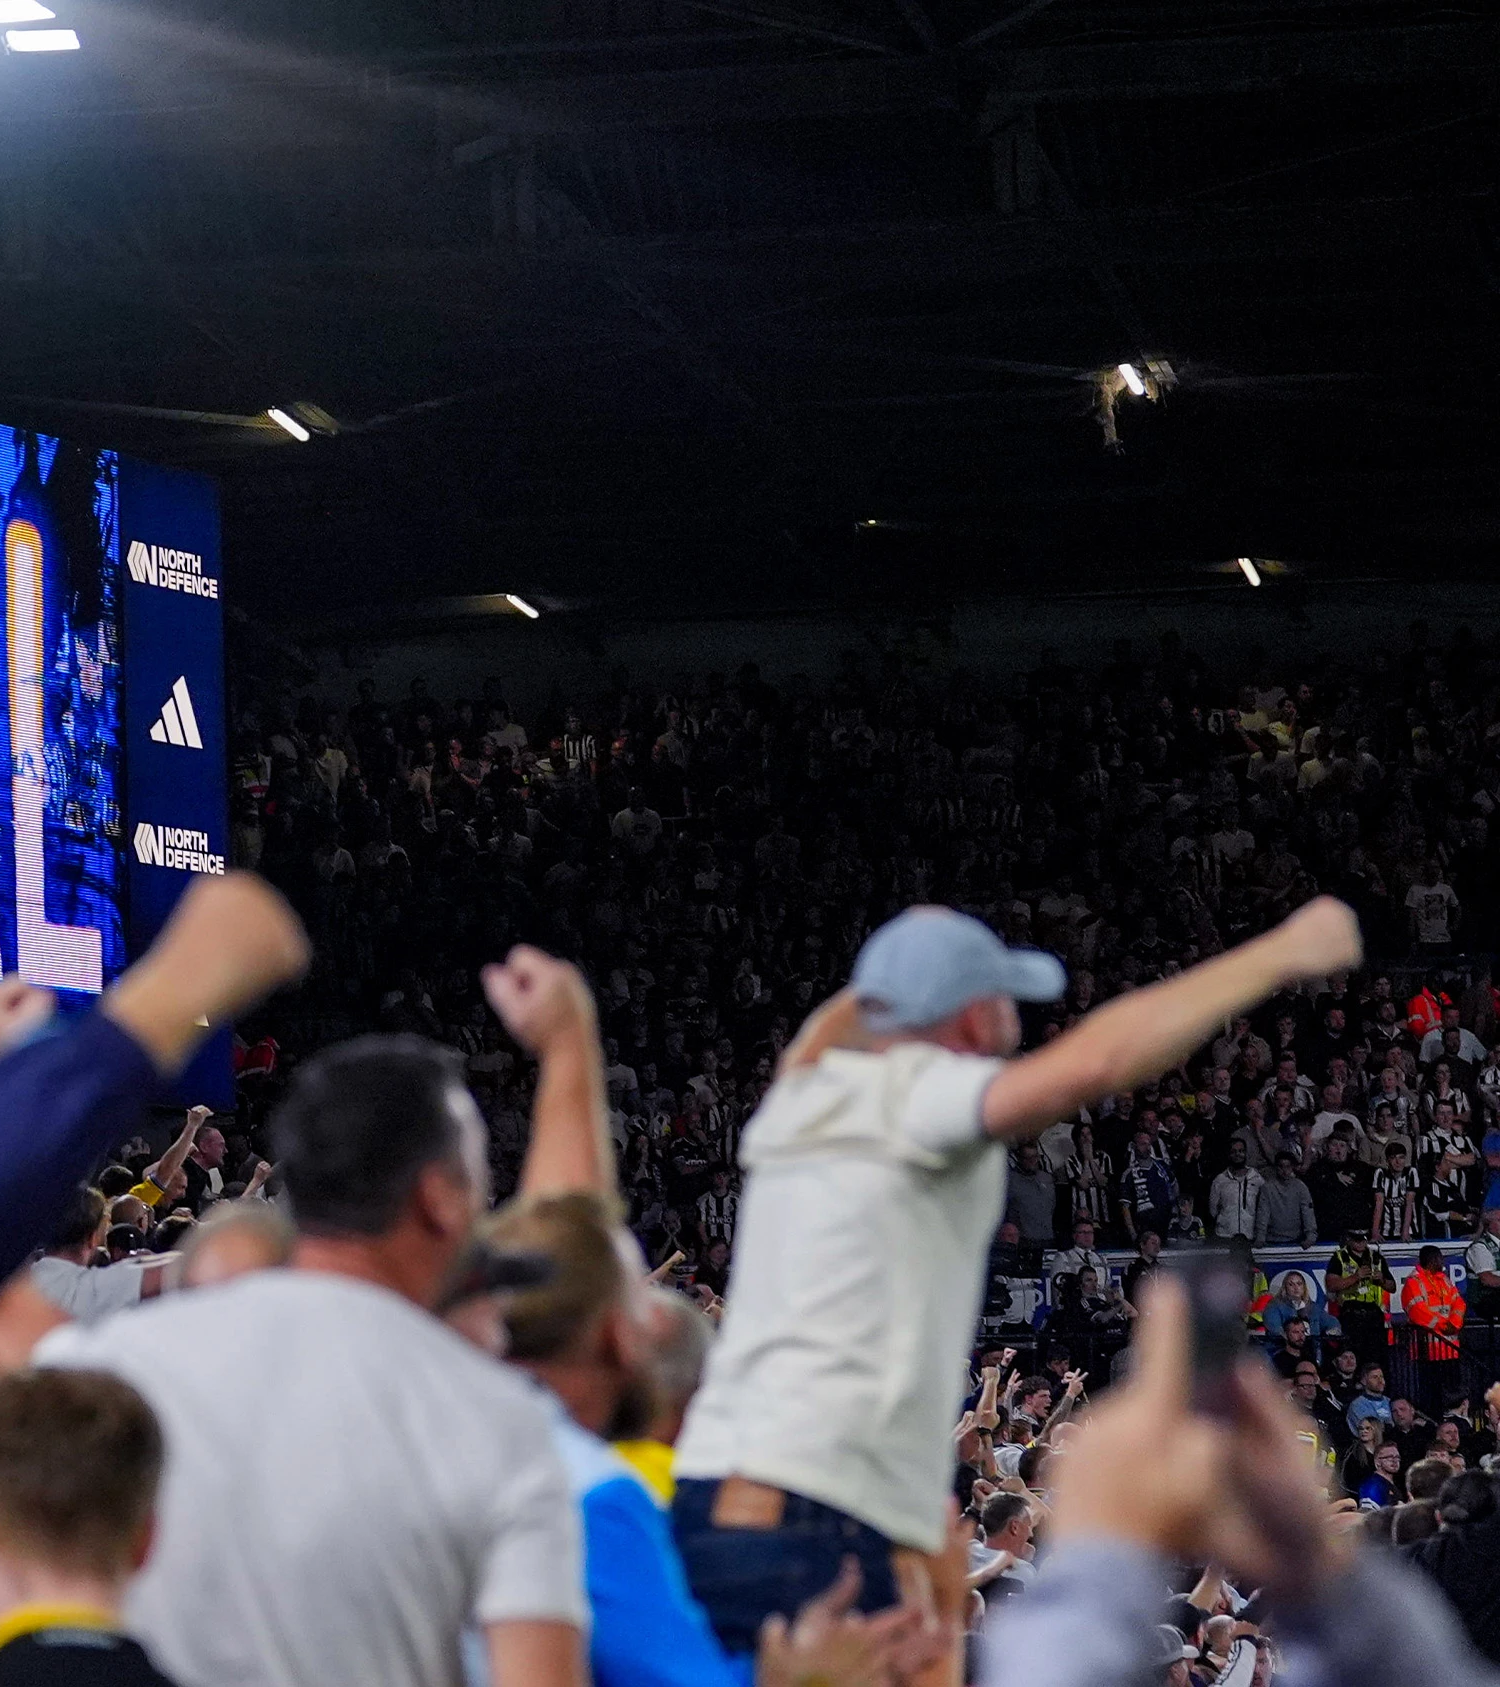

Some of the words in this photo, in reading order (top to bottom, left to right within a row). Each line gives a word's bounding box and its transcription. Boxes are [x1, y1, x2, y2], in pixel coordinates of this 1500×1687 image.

[159, 547, 201, 575] NORTH
[159, 568, 217, 598] DEFENCE
[165, 826, 208, 852] NORTH
[165, 847, 224, 875] DEFENCE
